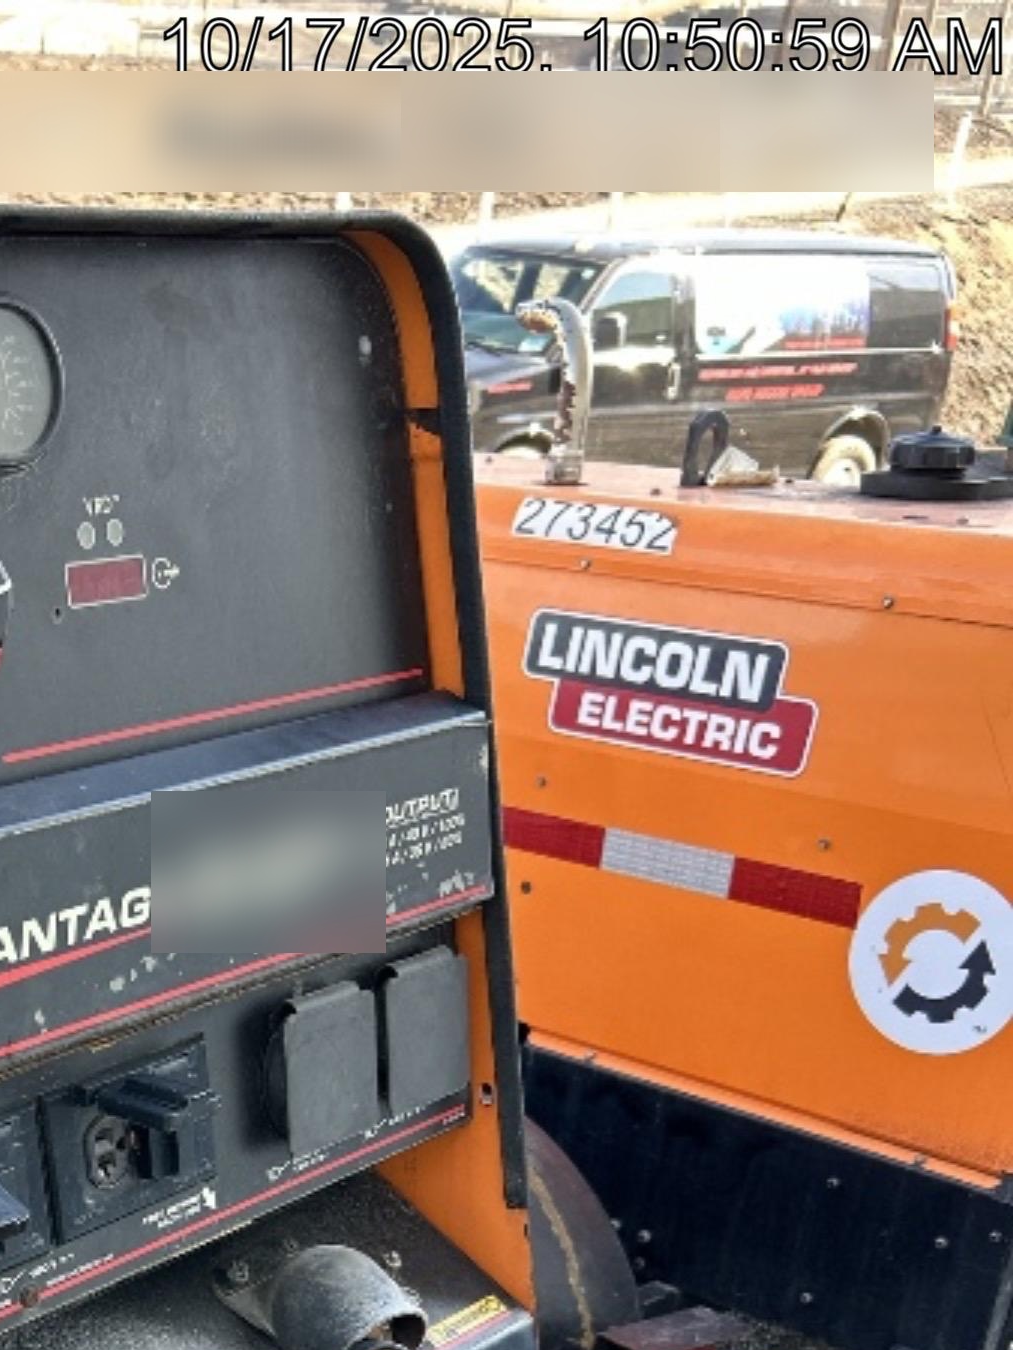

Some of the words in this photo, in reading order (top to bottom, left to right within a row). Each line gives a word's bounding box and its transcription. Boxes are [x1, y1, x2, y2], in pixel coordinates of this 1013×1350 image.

[515, 498, 676, 551] 273452
[537, 622, 770, 702] LINCOLN
[577, 691, 782, 759] ELECTRIC
